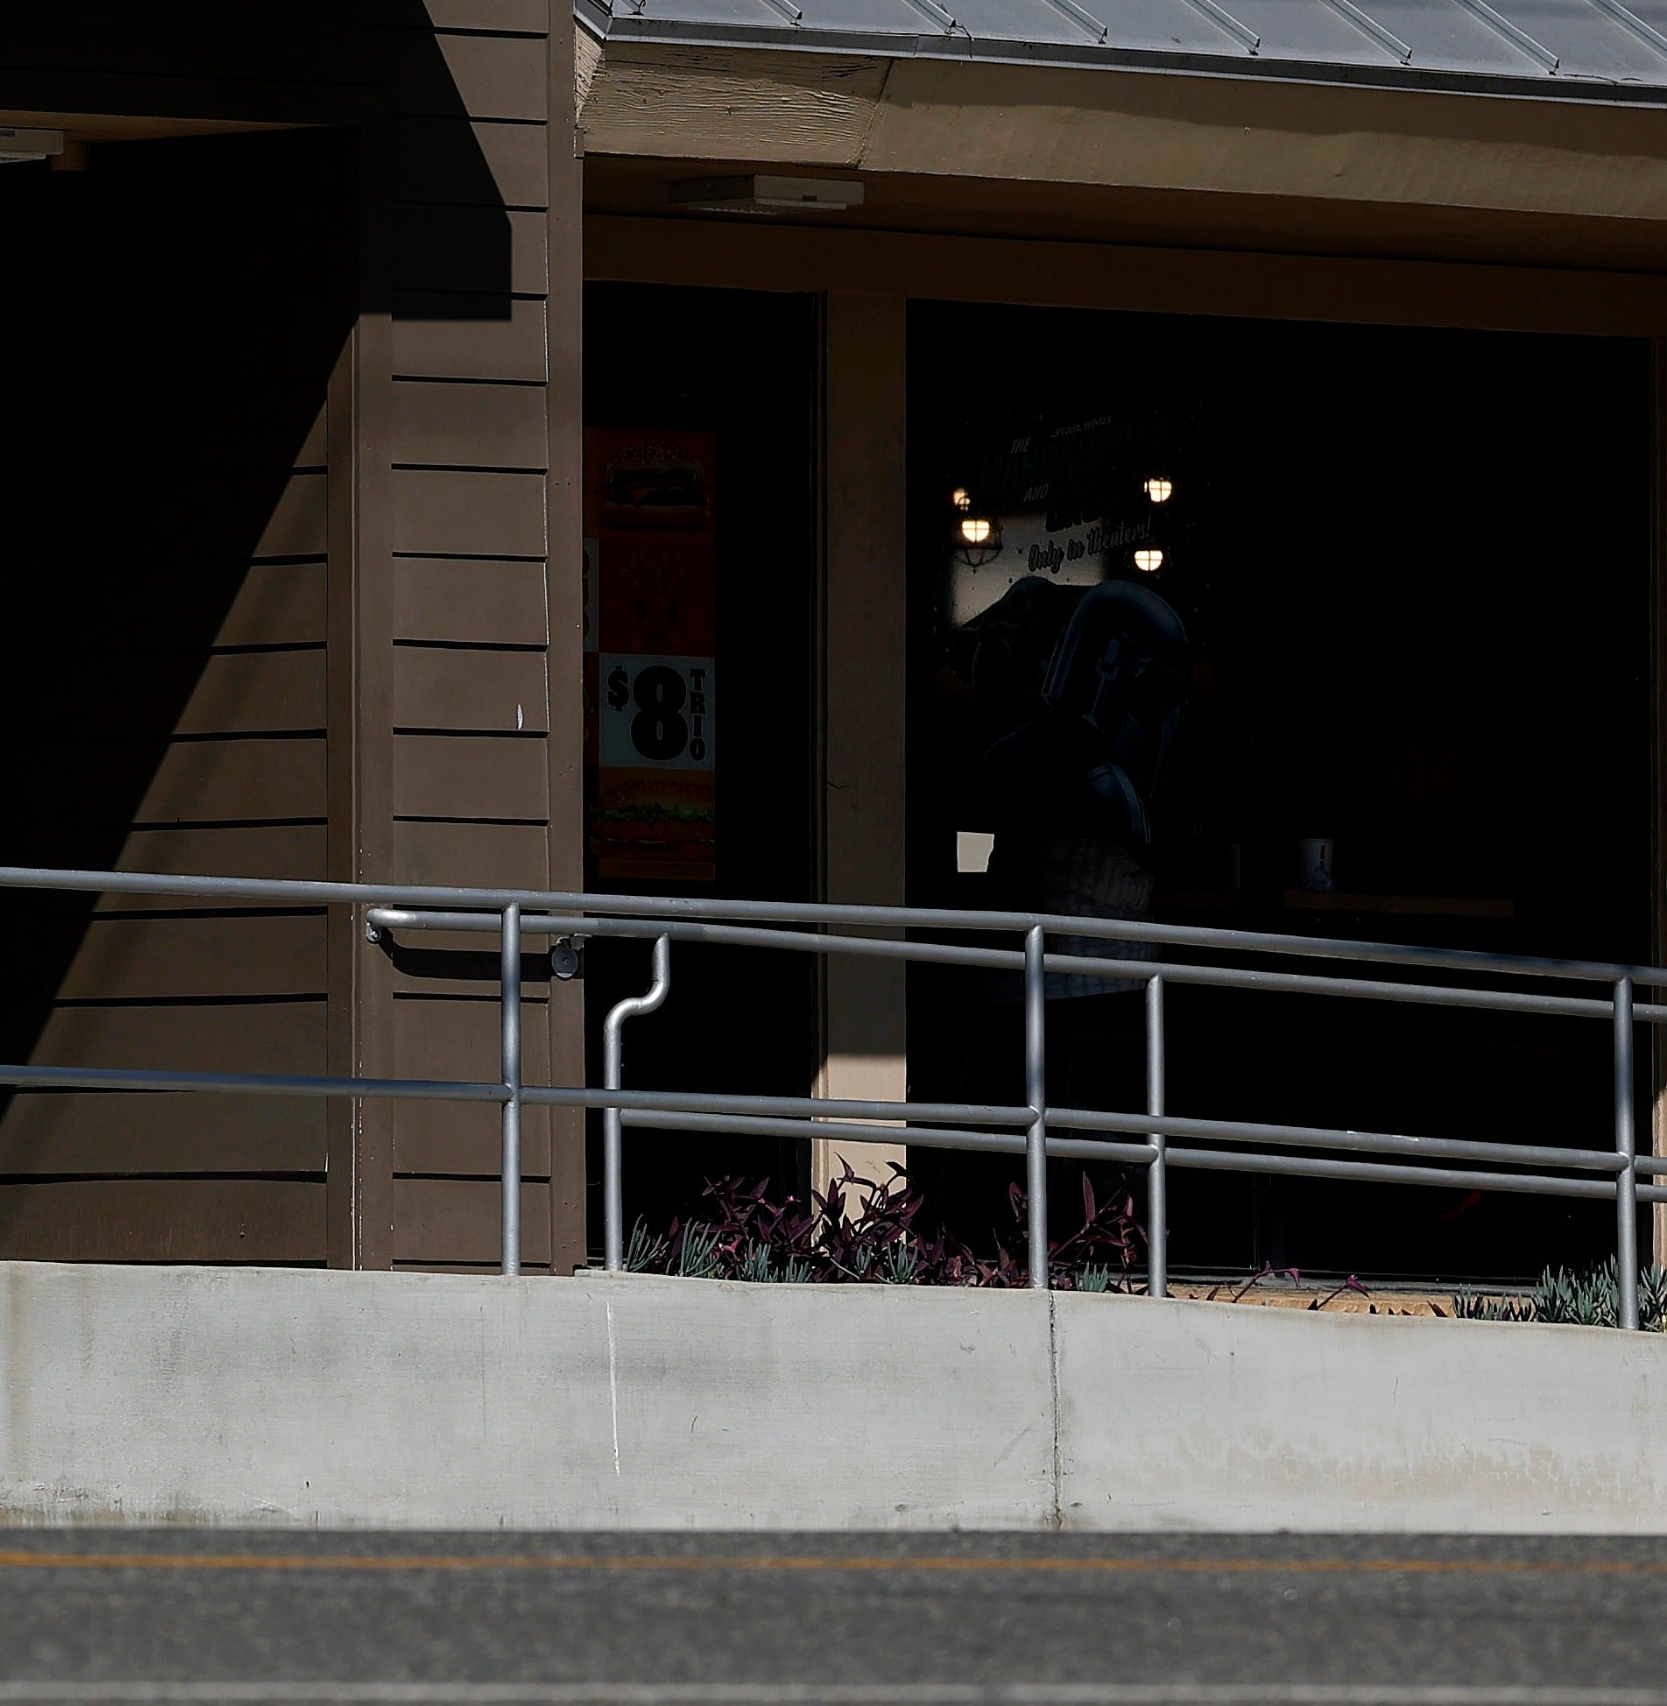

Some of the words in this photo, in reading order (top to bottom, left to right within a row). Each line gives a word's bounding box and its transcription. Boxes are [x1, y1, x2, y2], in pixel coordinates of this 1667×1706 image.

[1011, 437, 1031, 455] THE
[1023, 483, 1049, 503] AND
[1028, 539, 1064, 574] Only
[1067, 537, 1086, 561] in
[1087, 513, 1152, 555] theaters!
